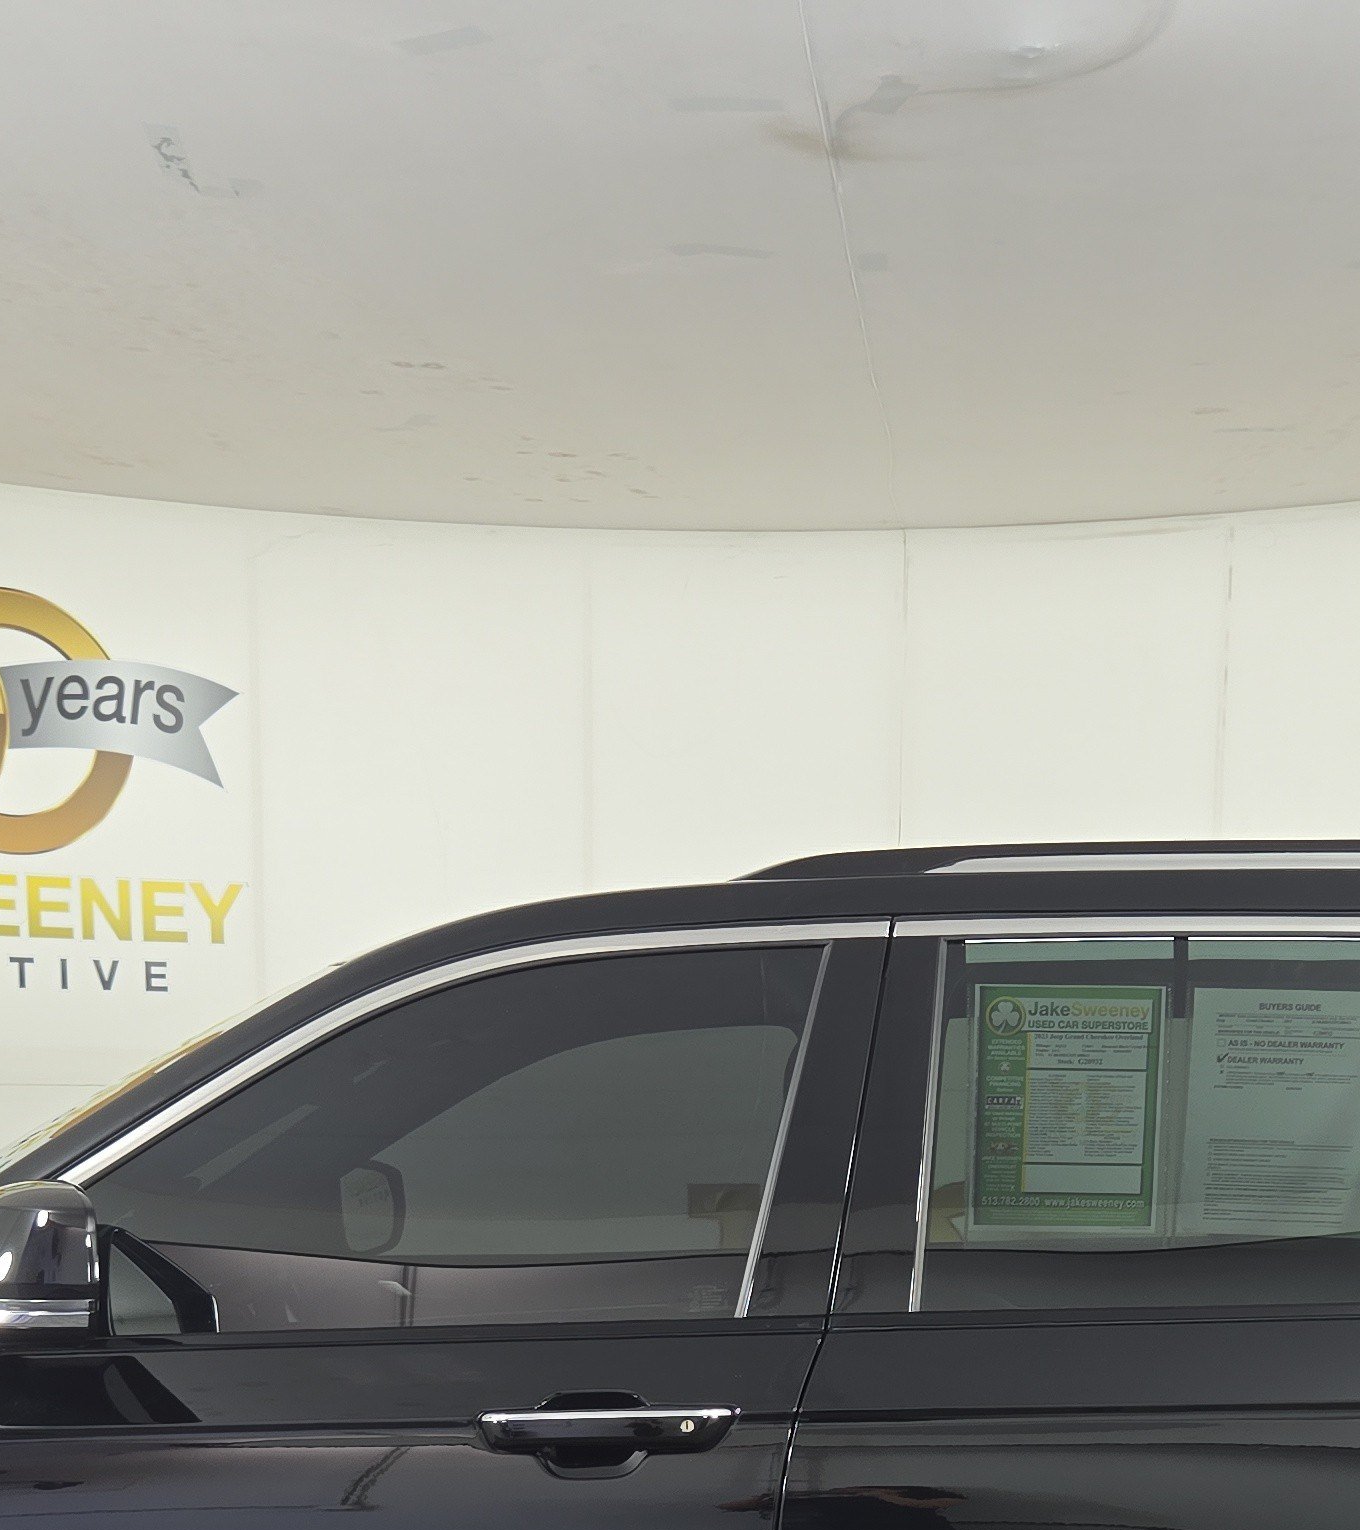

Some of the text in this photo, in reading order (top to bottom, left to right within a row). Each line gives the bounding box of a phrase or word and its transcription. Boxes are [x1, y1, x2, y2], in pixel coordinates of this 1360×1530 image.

[20, 671, 185, 736] years
[1259, 1002, 1322, 1011] BUYERS GUIDE
[1028, 1020, 1149, 1031] USED CAR SUPERSTORE
[1228, 1039, 1239, 1047] AS
[1254, 1040, 1266, 1048] NO
[1300, 1042, 1345, 1050] WARRANTY
[1228, 1056, 1304, 1065] DEALER WARRANTY
